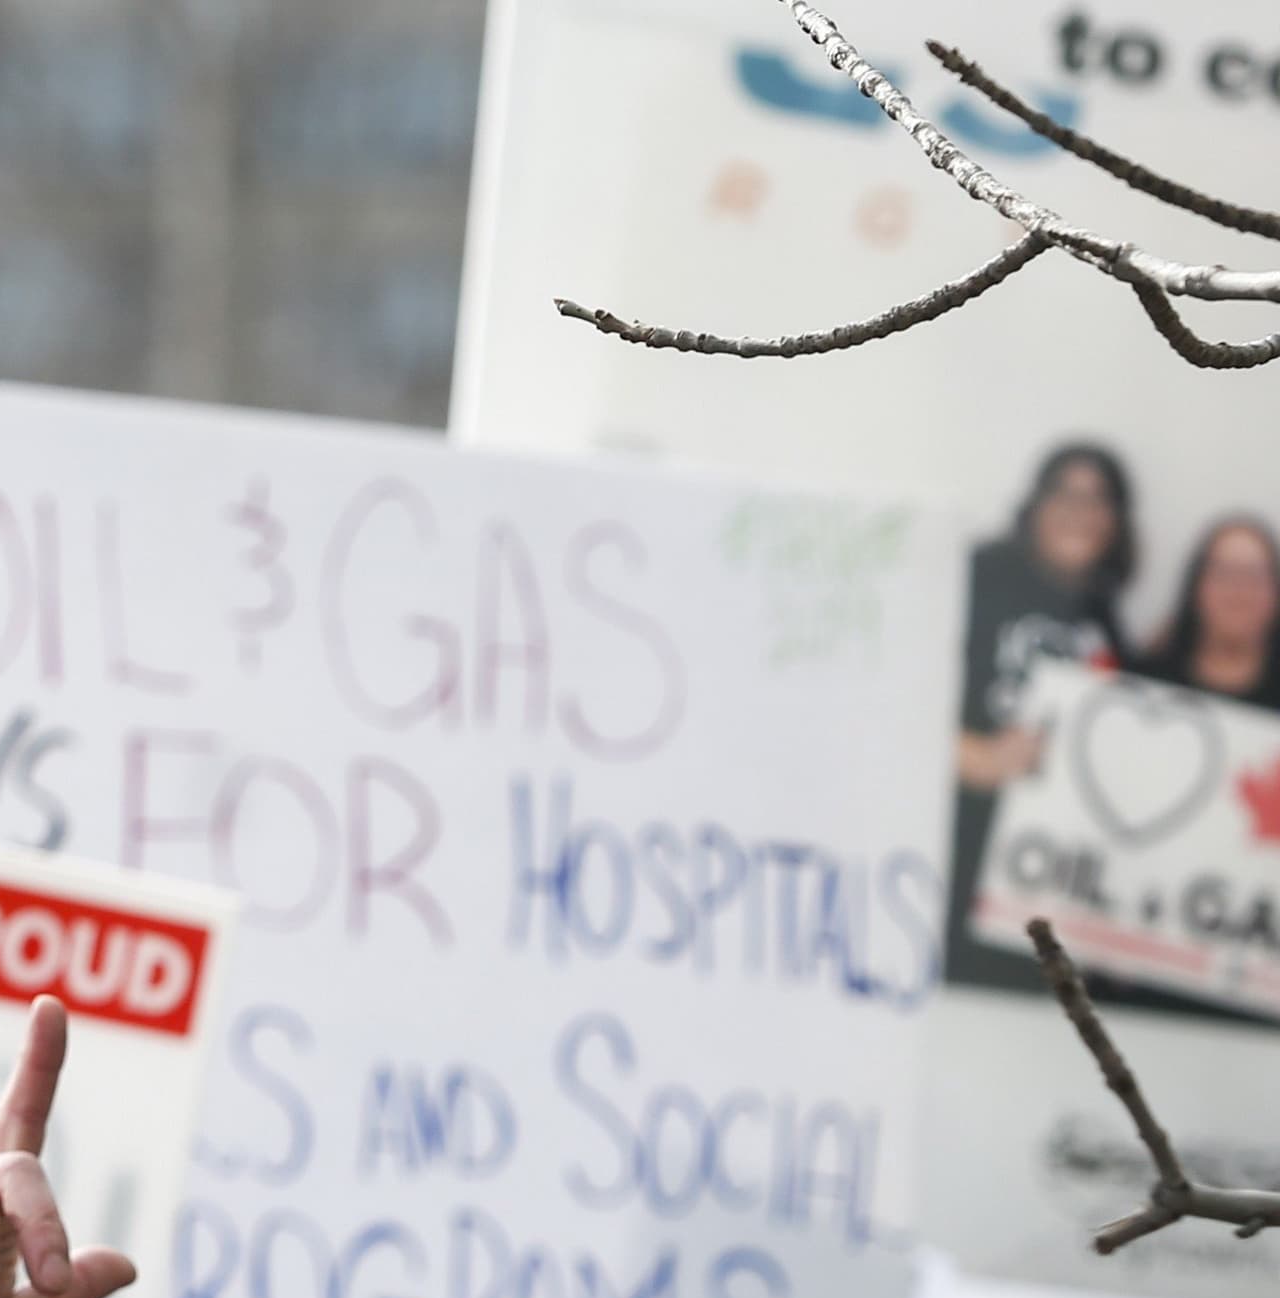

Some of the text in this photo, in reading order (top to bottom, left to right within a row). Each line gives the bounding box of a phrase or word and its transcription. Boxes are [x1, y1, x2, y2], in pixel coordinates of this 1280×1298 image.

[1057, 12, 1164, 86] to
[321, 474, 689, 761] GAS
[119, 729, 455, 949] FOR
